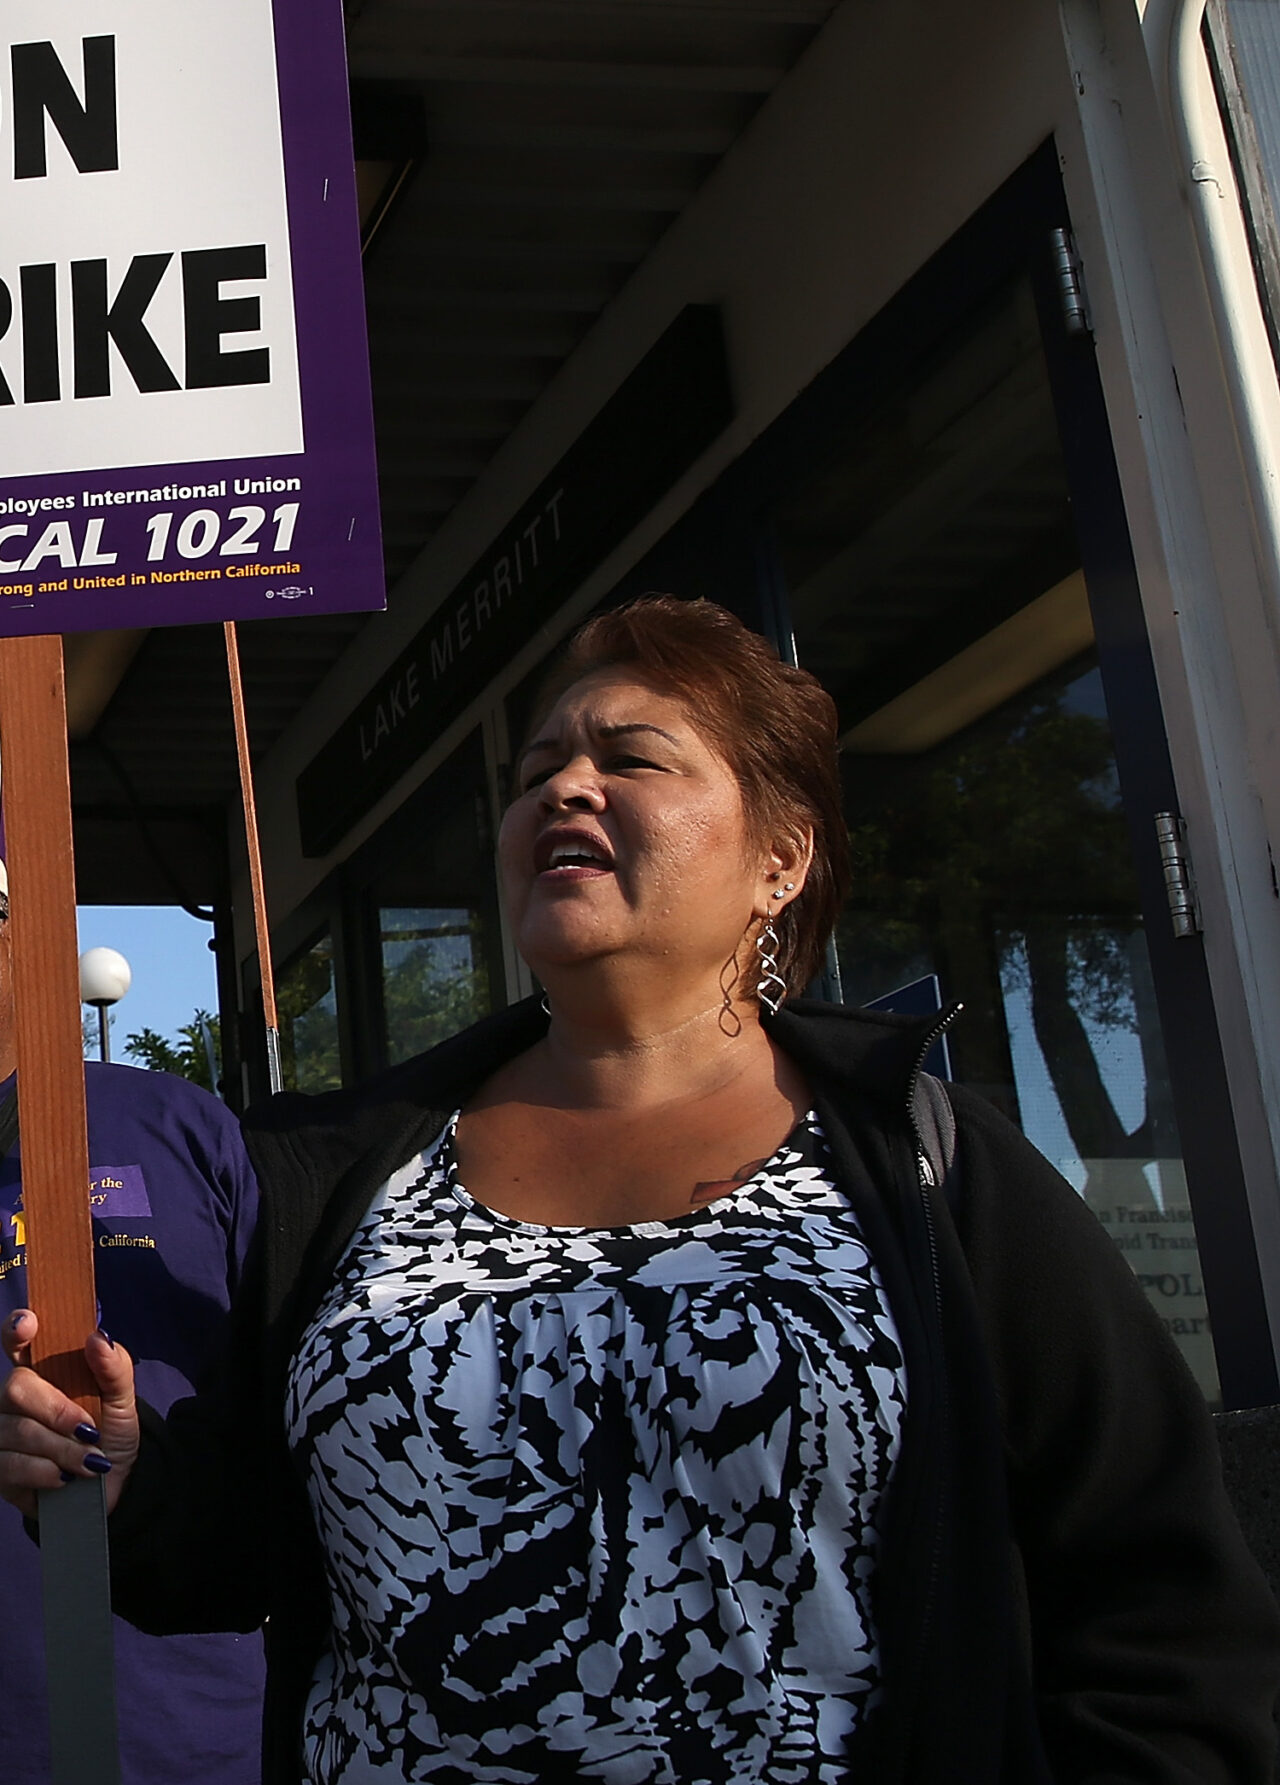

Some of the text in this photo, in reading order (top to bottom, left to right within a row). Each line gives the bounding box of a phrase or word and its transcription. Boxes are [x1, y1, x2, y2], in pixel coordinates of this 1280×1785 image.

[82, 480, 226, 507] International
[234, 476, 301, 495] Union
[145, 502, 300, 562] 1021
[38, 579, 67, 593] and
[73, 574, 125, 590] United
[131, 573, 146, 586] in
[151, 568, 221, 584] Northern
[226, 561, 300, 578] California
[358, 487, 565, 762] LAKE MERRITT
[101, 1177, 123, 1189] the
[99, 1233, 156, 1249] California
